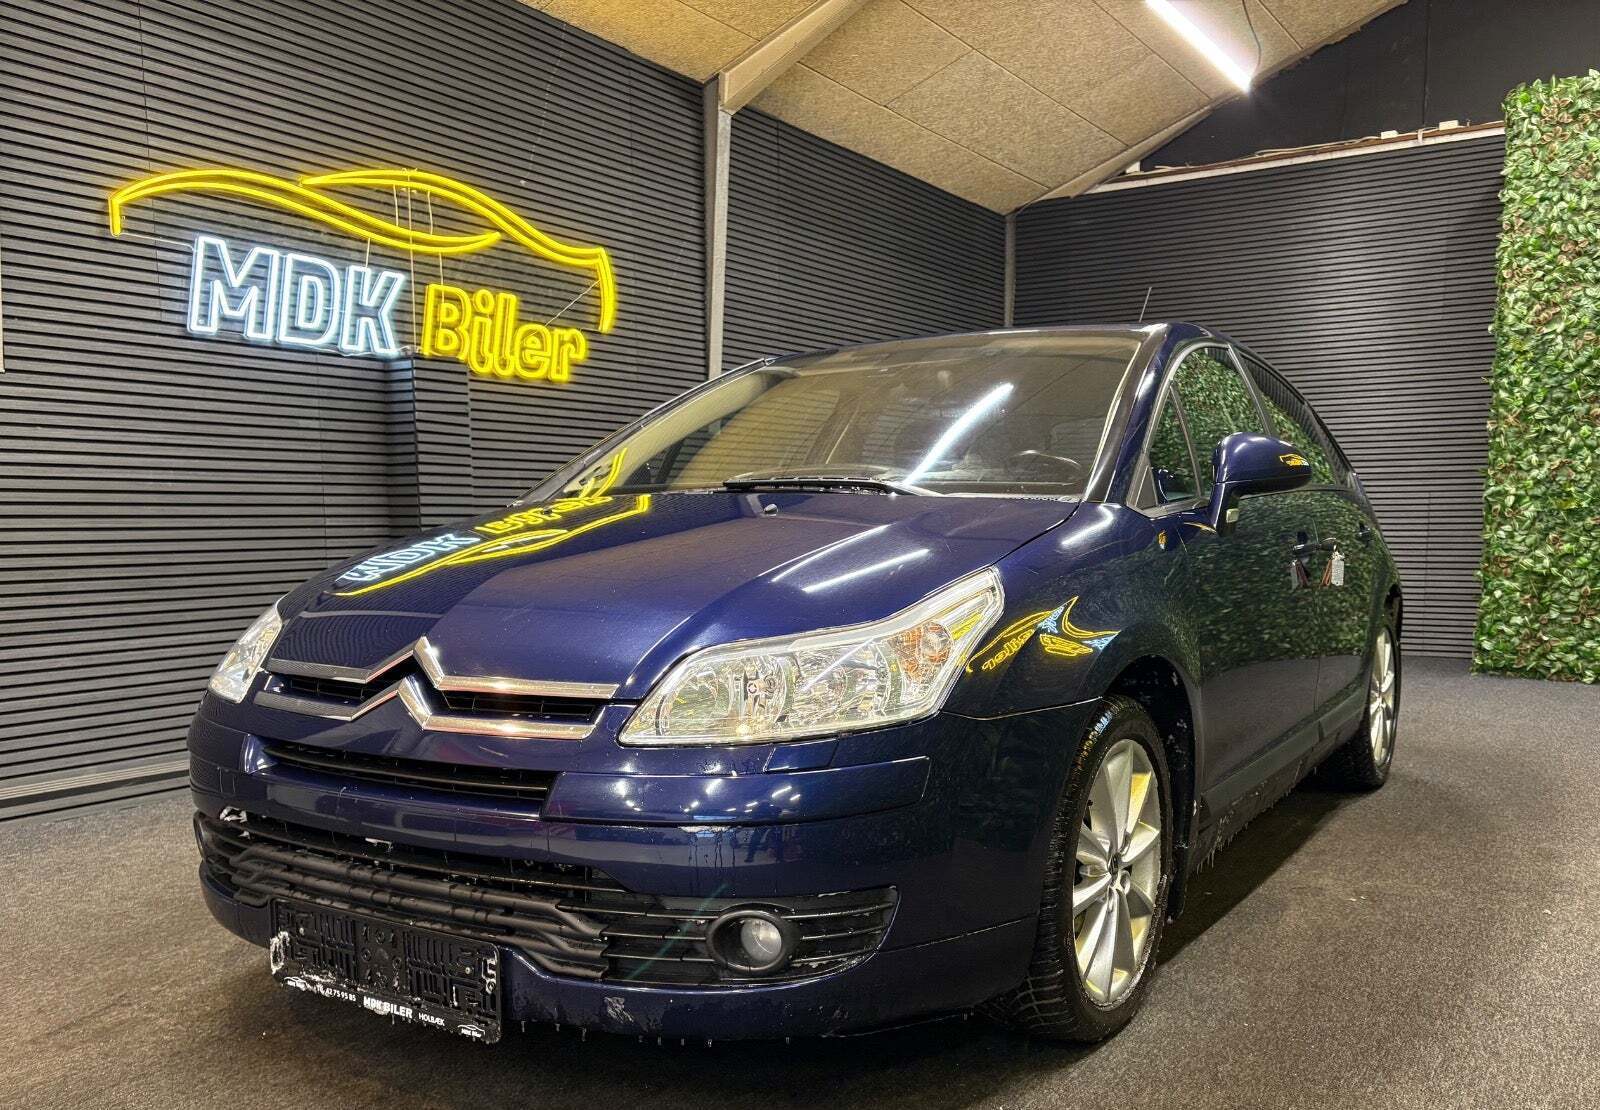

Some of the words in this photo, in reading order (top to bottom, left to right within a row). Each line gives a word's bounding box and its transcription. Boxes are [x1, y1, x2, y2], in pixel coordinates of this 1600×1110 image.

[187, 234, 405, 357] MDK
[421, 282, 589, 383] Biler
[383, 1000, 413, 1019] BILER
